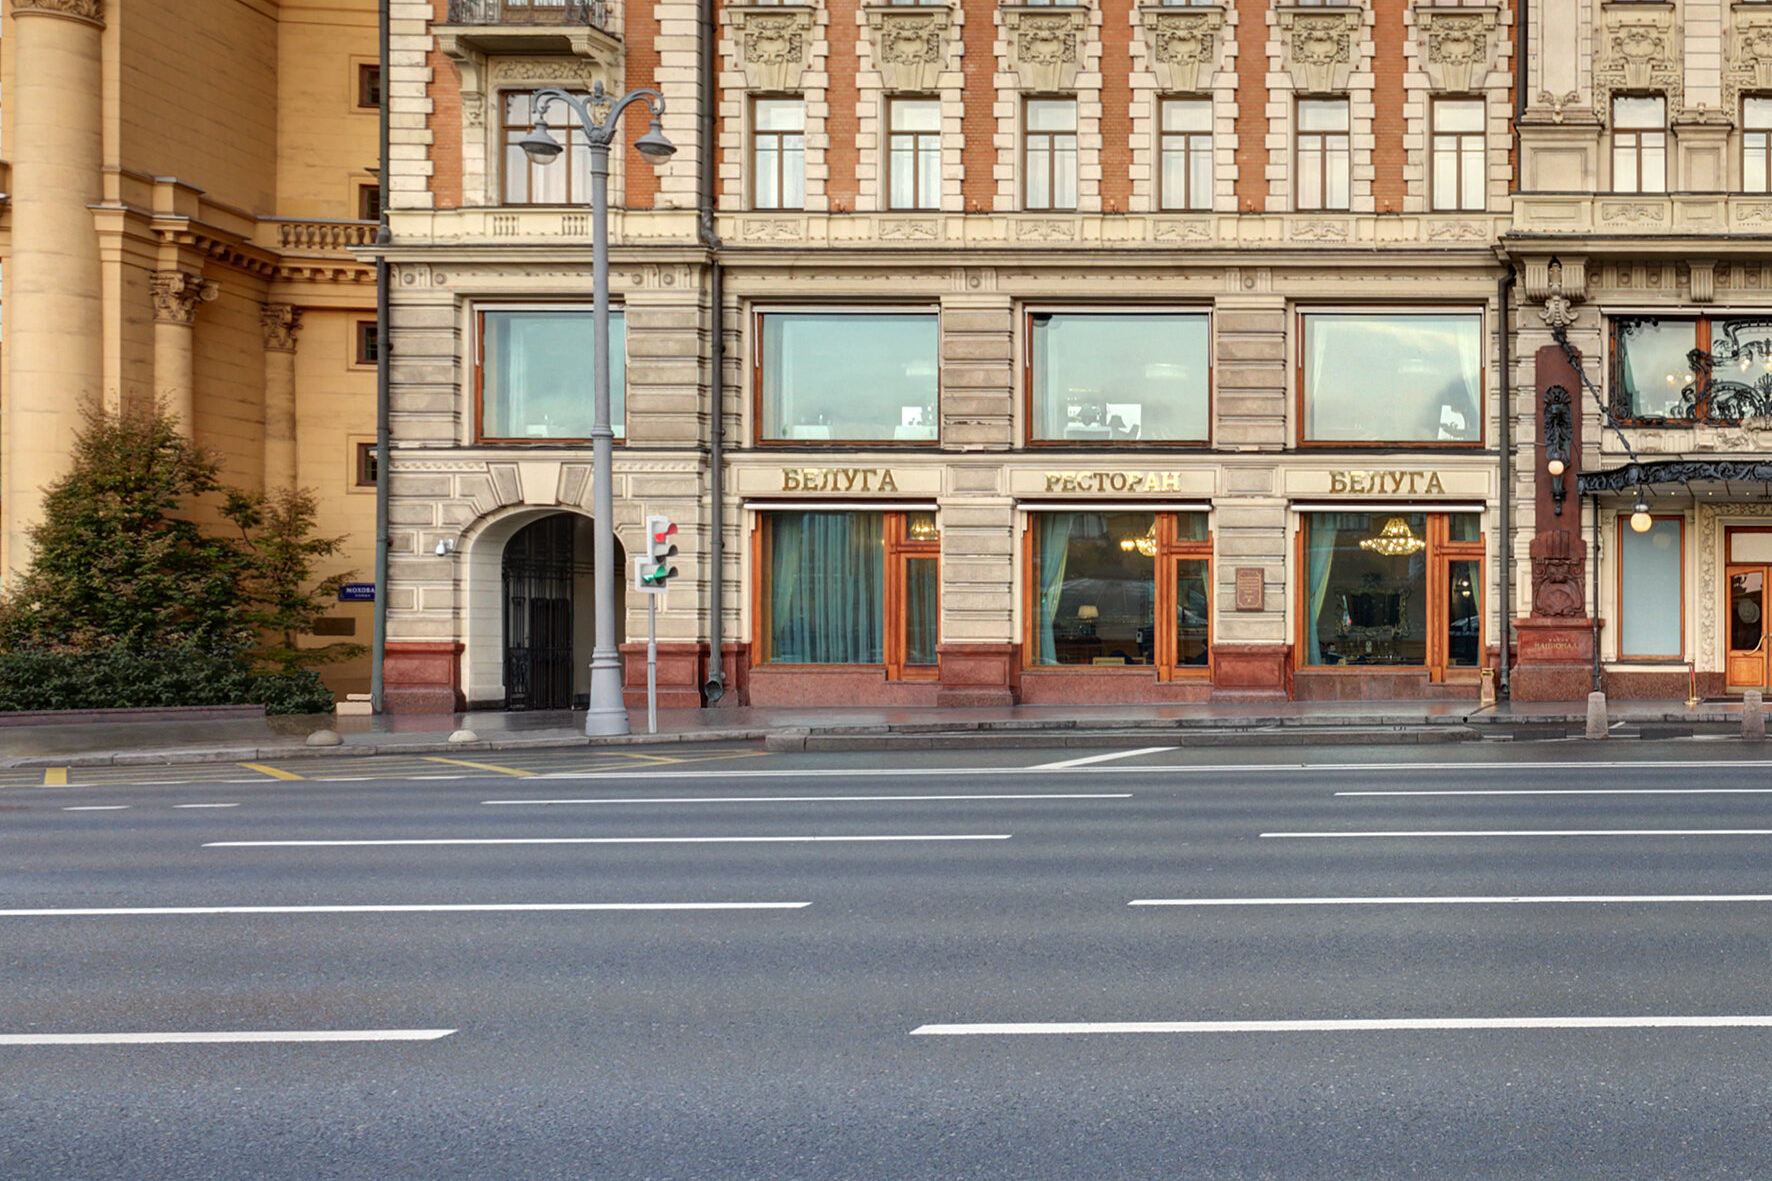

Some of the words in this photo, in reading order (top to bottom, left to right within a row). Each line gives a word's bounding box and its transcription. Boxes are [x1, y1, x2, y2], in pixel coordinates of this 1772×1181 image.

[782, 468, 898, 492] БЕЛУГА
[1044, 471, 1182, 493] РЕСТОРАН
[1329, 470, 1446, 494] БЕЛУГА
